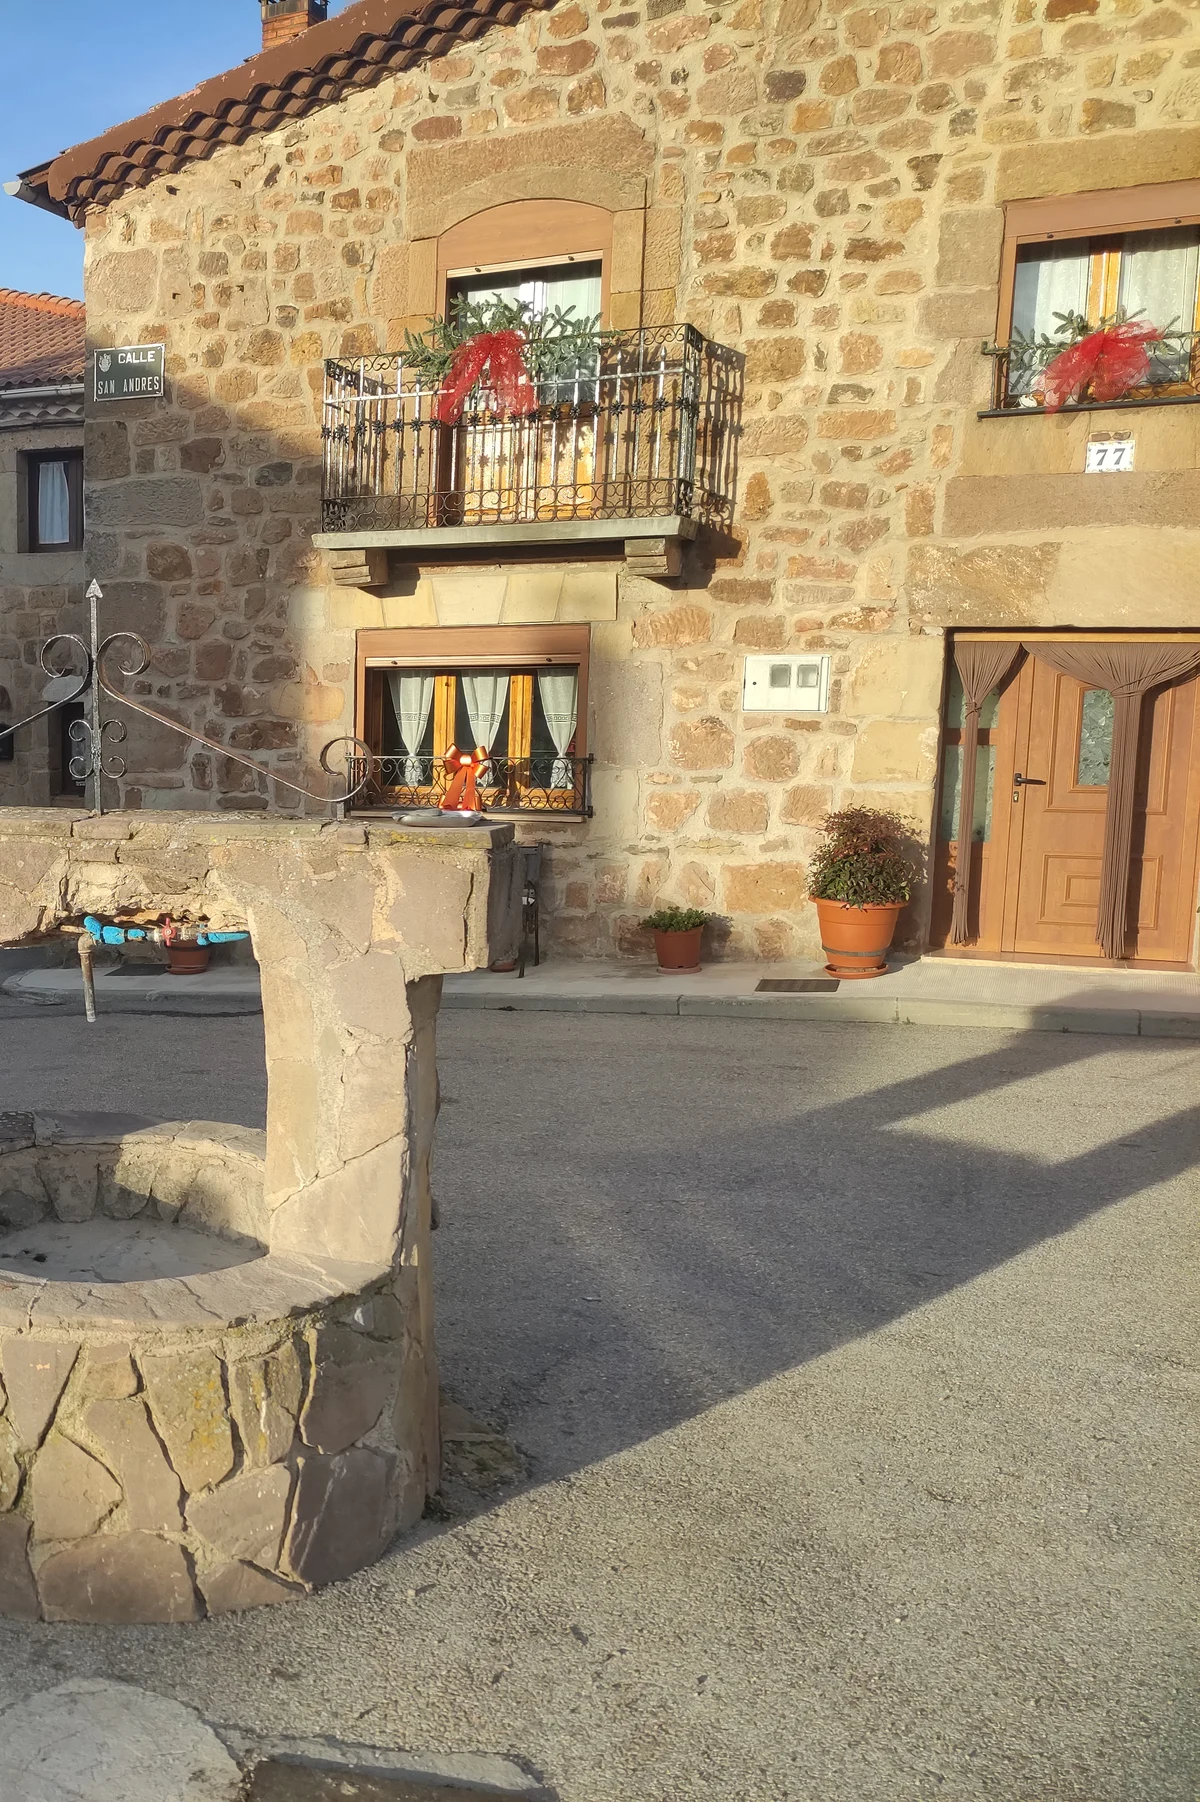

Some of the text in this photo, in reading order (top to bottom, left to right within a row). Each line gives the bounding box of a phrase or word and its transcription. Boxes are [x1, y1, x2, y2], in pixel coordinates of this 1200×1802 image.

[118, 351, 156, 364] CALLE
[98, 376, 160, 395] SAN ANDRES
[1095, 447, 1126, 467] 77
